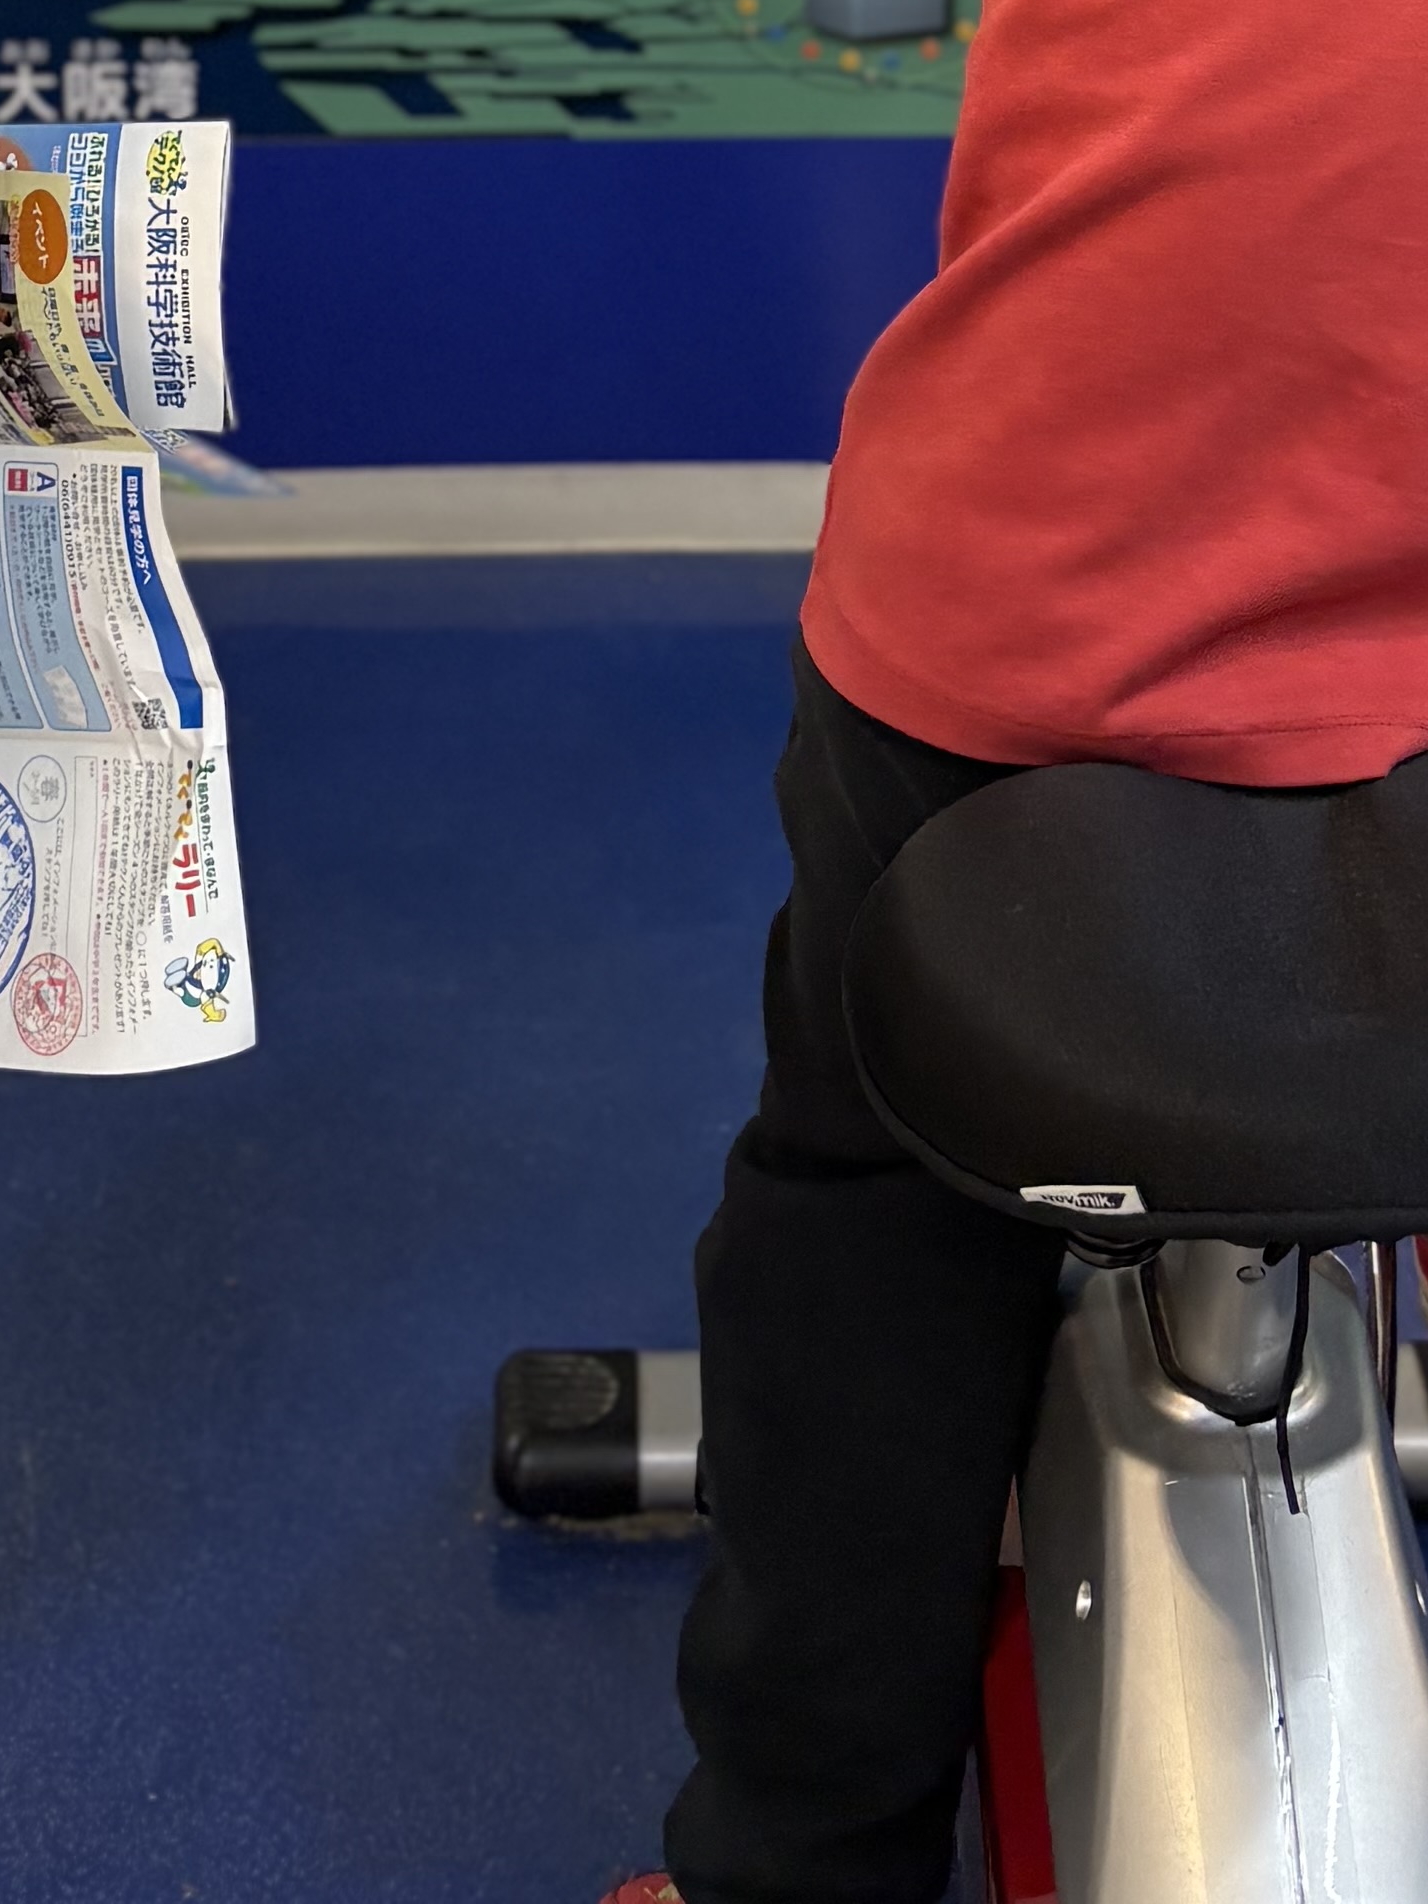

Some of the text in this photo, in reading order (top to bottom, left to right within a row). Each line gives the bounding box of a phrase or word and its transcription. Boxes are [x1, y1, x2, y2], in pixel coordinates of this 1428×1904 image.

[31, 202, 50, 270] イベント
[146, 196, 186, 409] 大阪科学技術館
[180, 268, 193, 345] EXHIBITION
[185, 355, 198, 389] HALL
[36, 471, 56, 492] A
[126, 475, 152, 585] 団体見学の方へ
[39, 776, 60, 803] 春
[172, 844, 202, 919] ラリー
